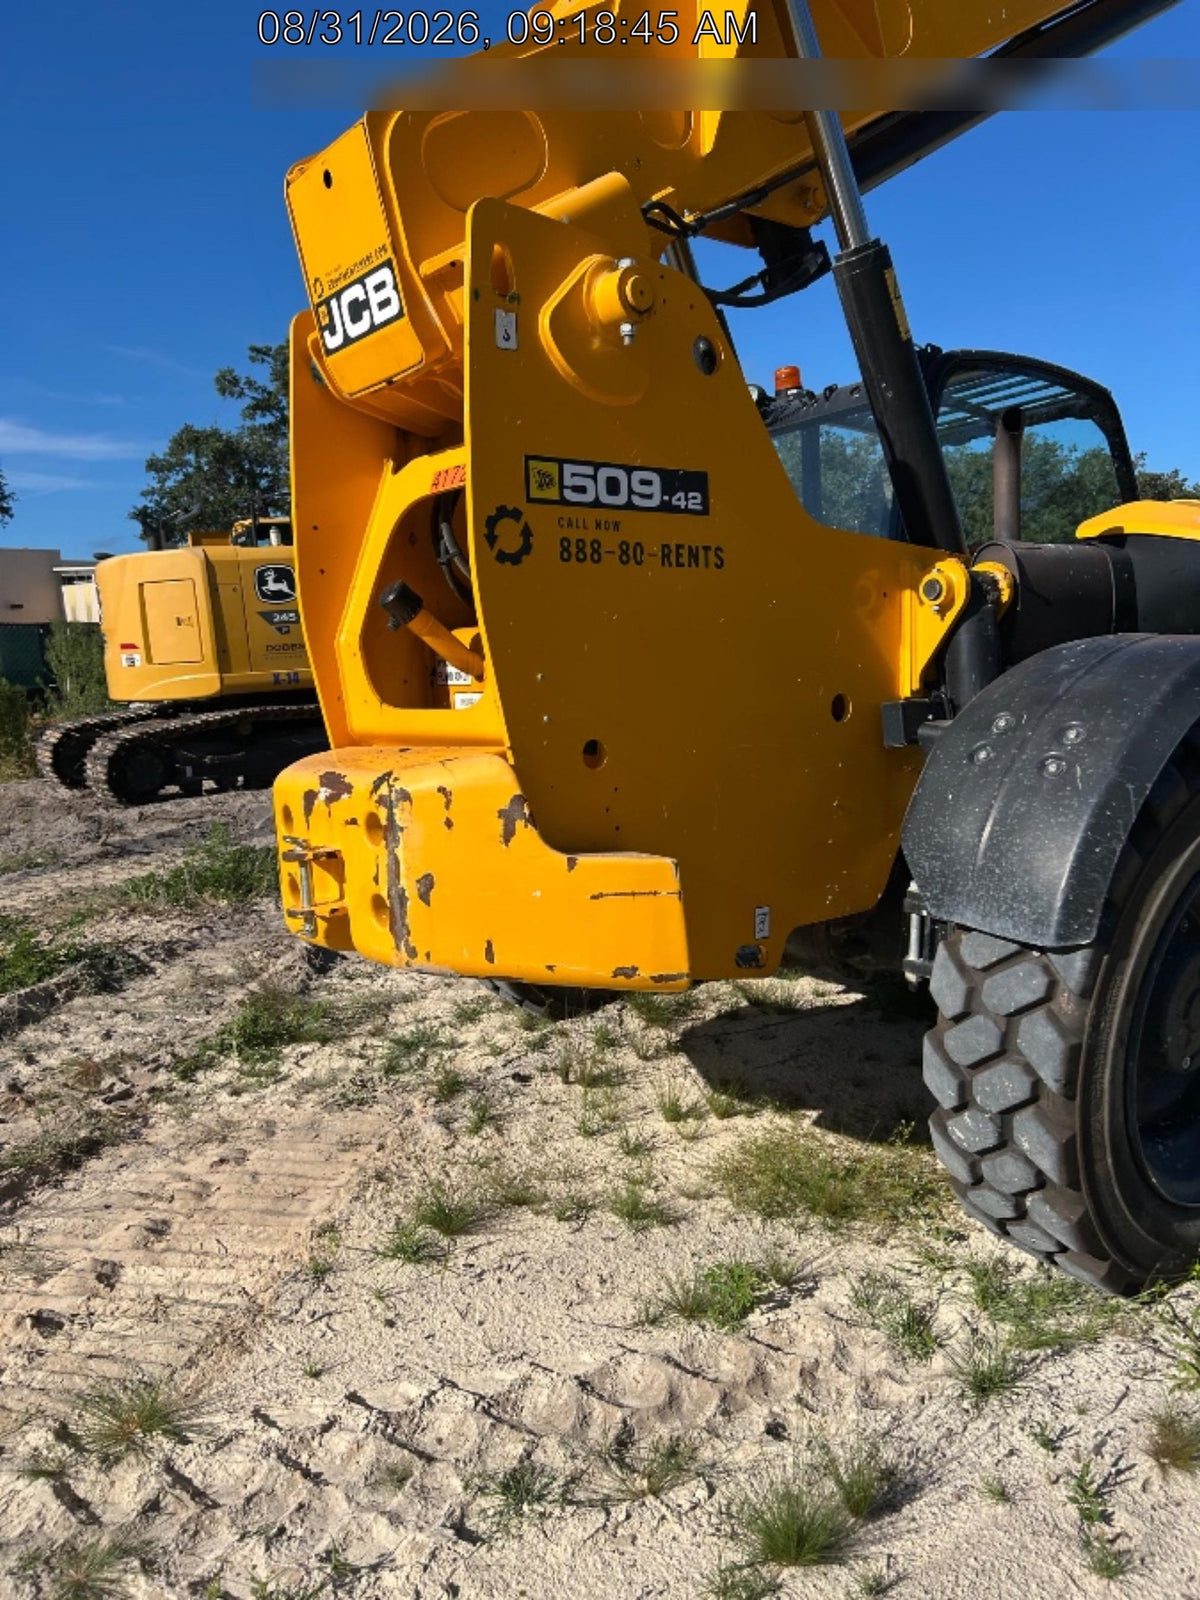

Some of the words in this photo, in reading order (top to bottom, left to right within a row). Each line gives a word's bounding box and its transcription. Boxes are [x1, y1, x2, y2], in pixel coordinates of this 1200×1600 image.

[323, 267, 401, 350] JCB
[562, 463, 704, 511] 509-42
[557, 516, 589, 531] CALL
[594, 518, 622, 532] NOW
[559, 537, 725, 570] 888-80-RENTS
